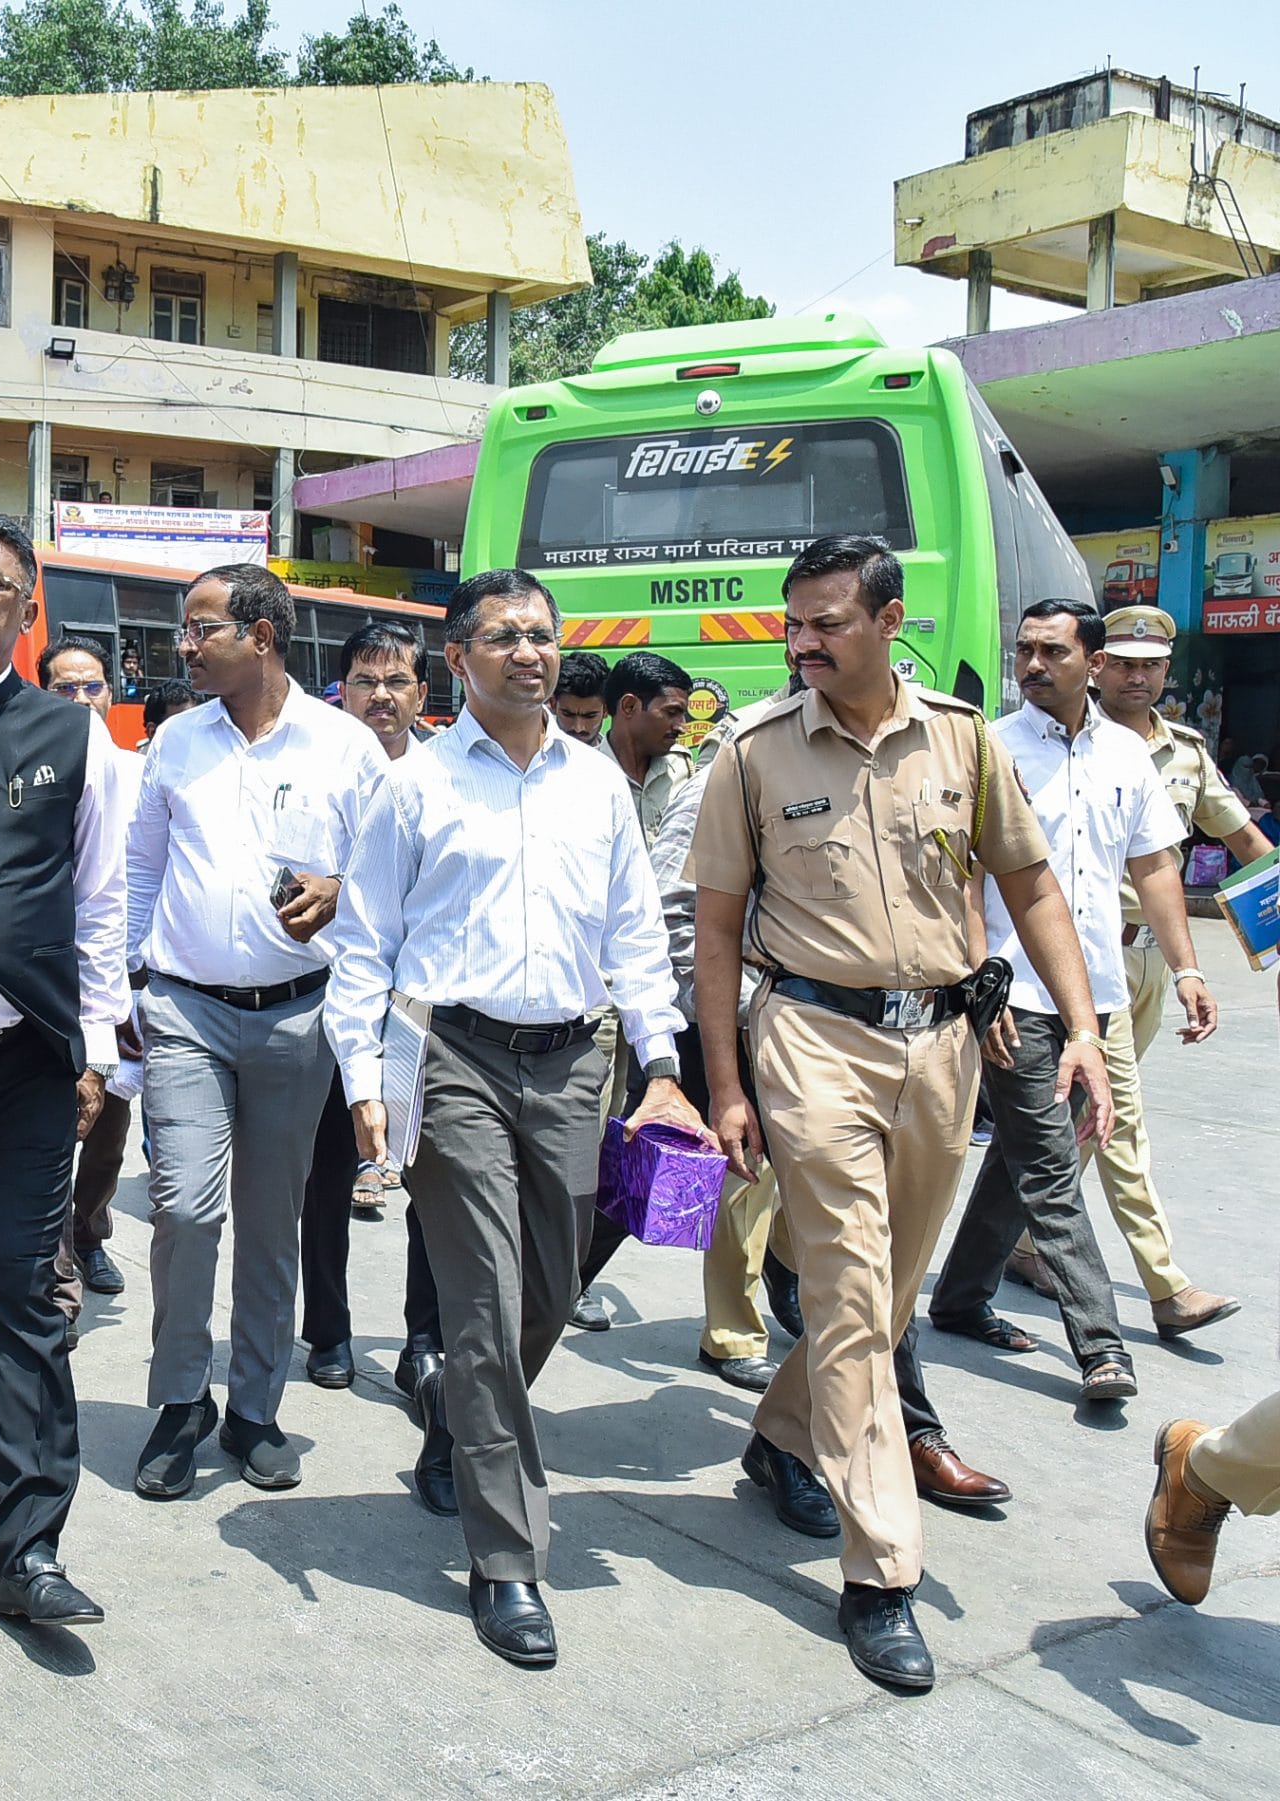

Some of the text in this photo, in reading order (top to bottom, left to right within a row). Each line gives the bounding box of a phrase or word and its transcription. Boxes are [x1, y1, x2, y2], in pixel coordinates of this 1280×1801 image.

[544, 547, 609, 564] महाराष्ट्र
[613, 547, 657, 561] राज्य
[663, 541, 703, 558] मार्ग
[706, 538, 784, 557] परिवहन
[651, 577, 744, 605] MSRTC
[1207, 603, 1260, 629] माऊली
[899, 663, 914, 675] अ
[737, 688, 778, 697] TOLL FRE
